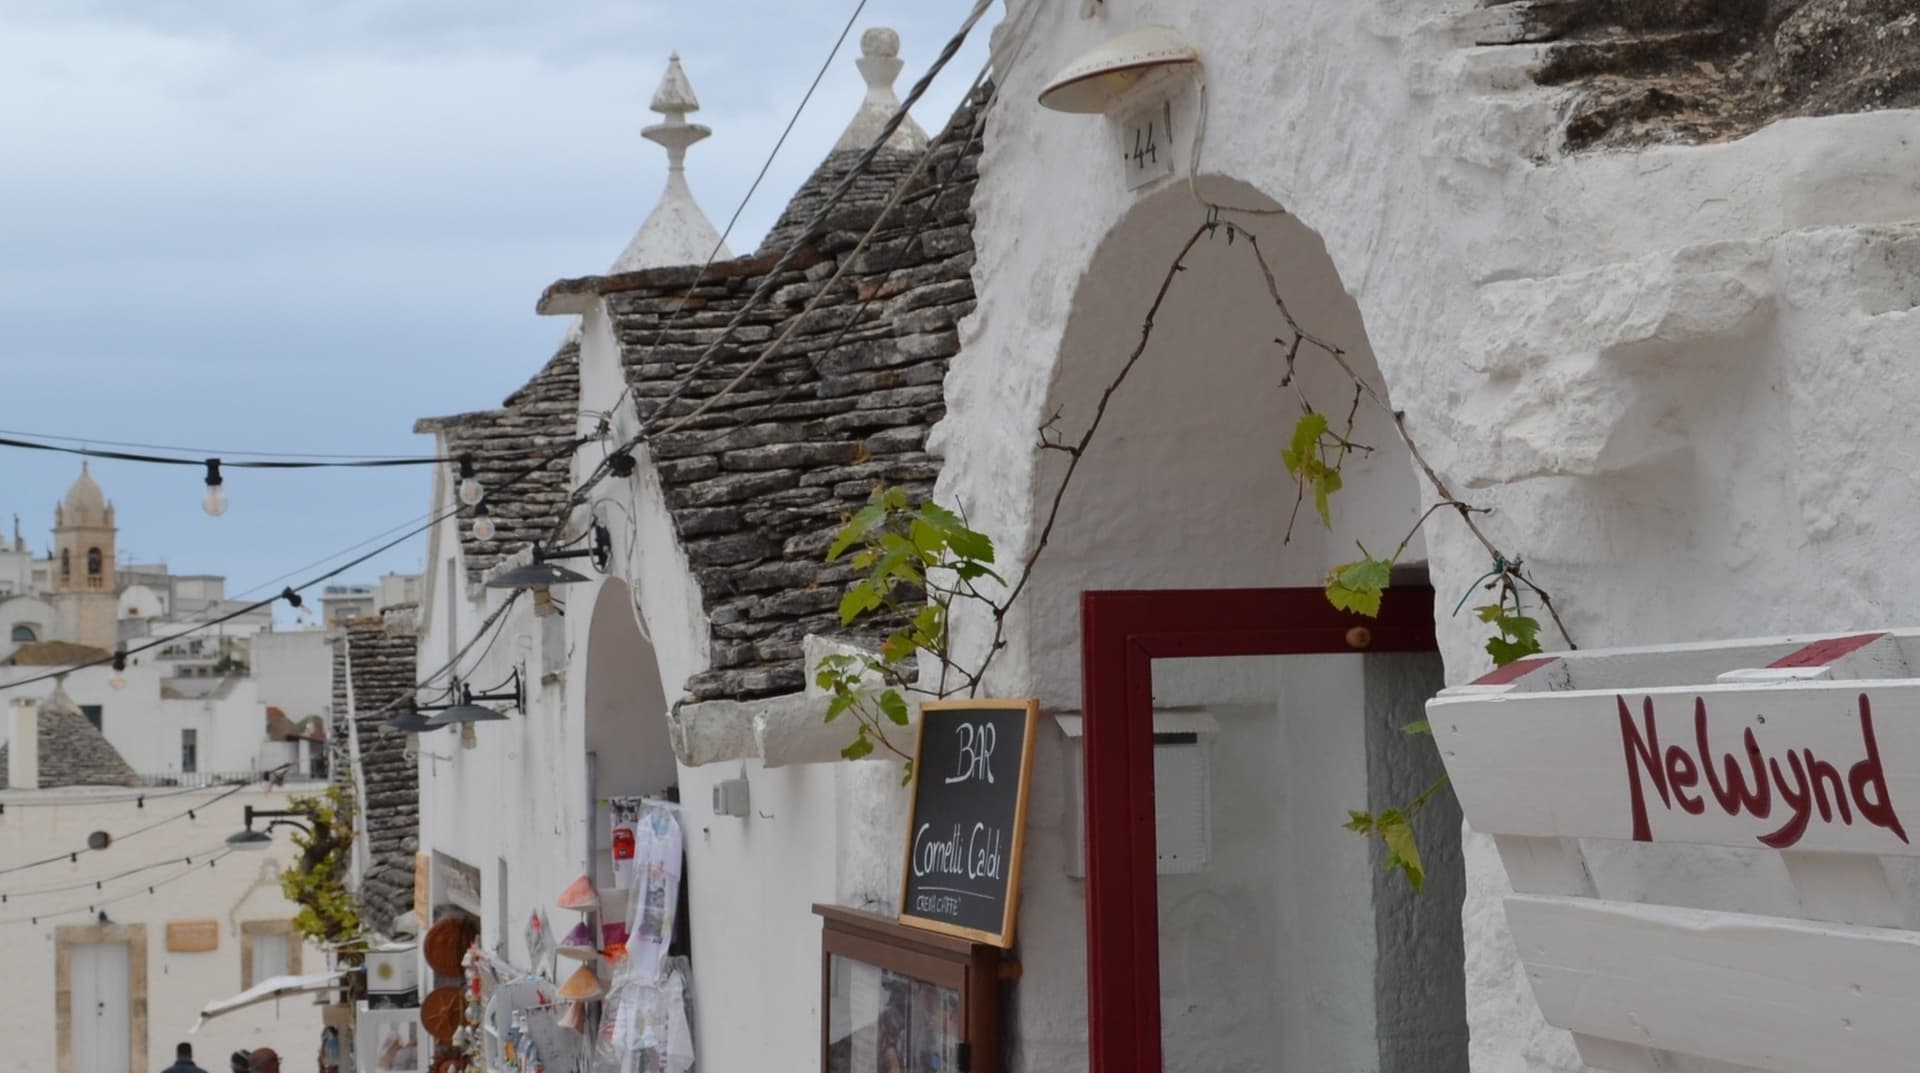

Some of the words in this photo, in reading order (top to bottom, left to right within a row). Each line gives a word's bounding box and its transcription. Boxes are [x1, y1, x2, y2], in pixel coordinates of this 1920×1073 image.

[1132, 121, 1157, 169] 44
[945, 721, 996, 784] BAR
[913, 822, 963, 877] Cornetti
[968, 822, 1001, 880] Caldi
